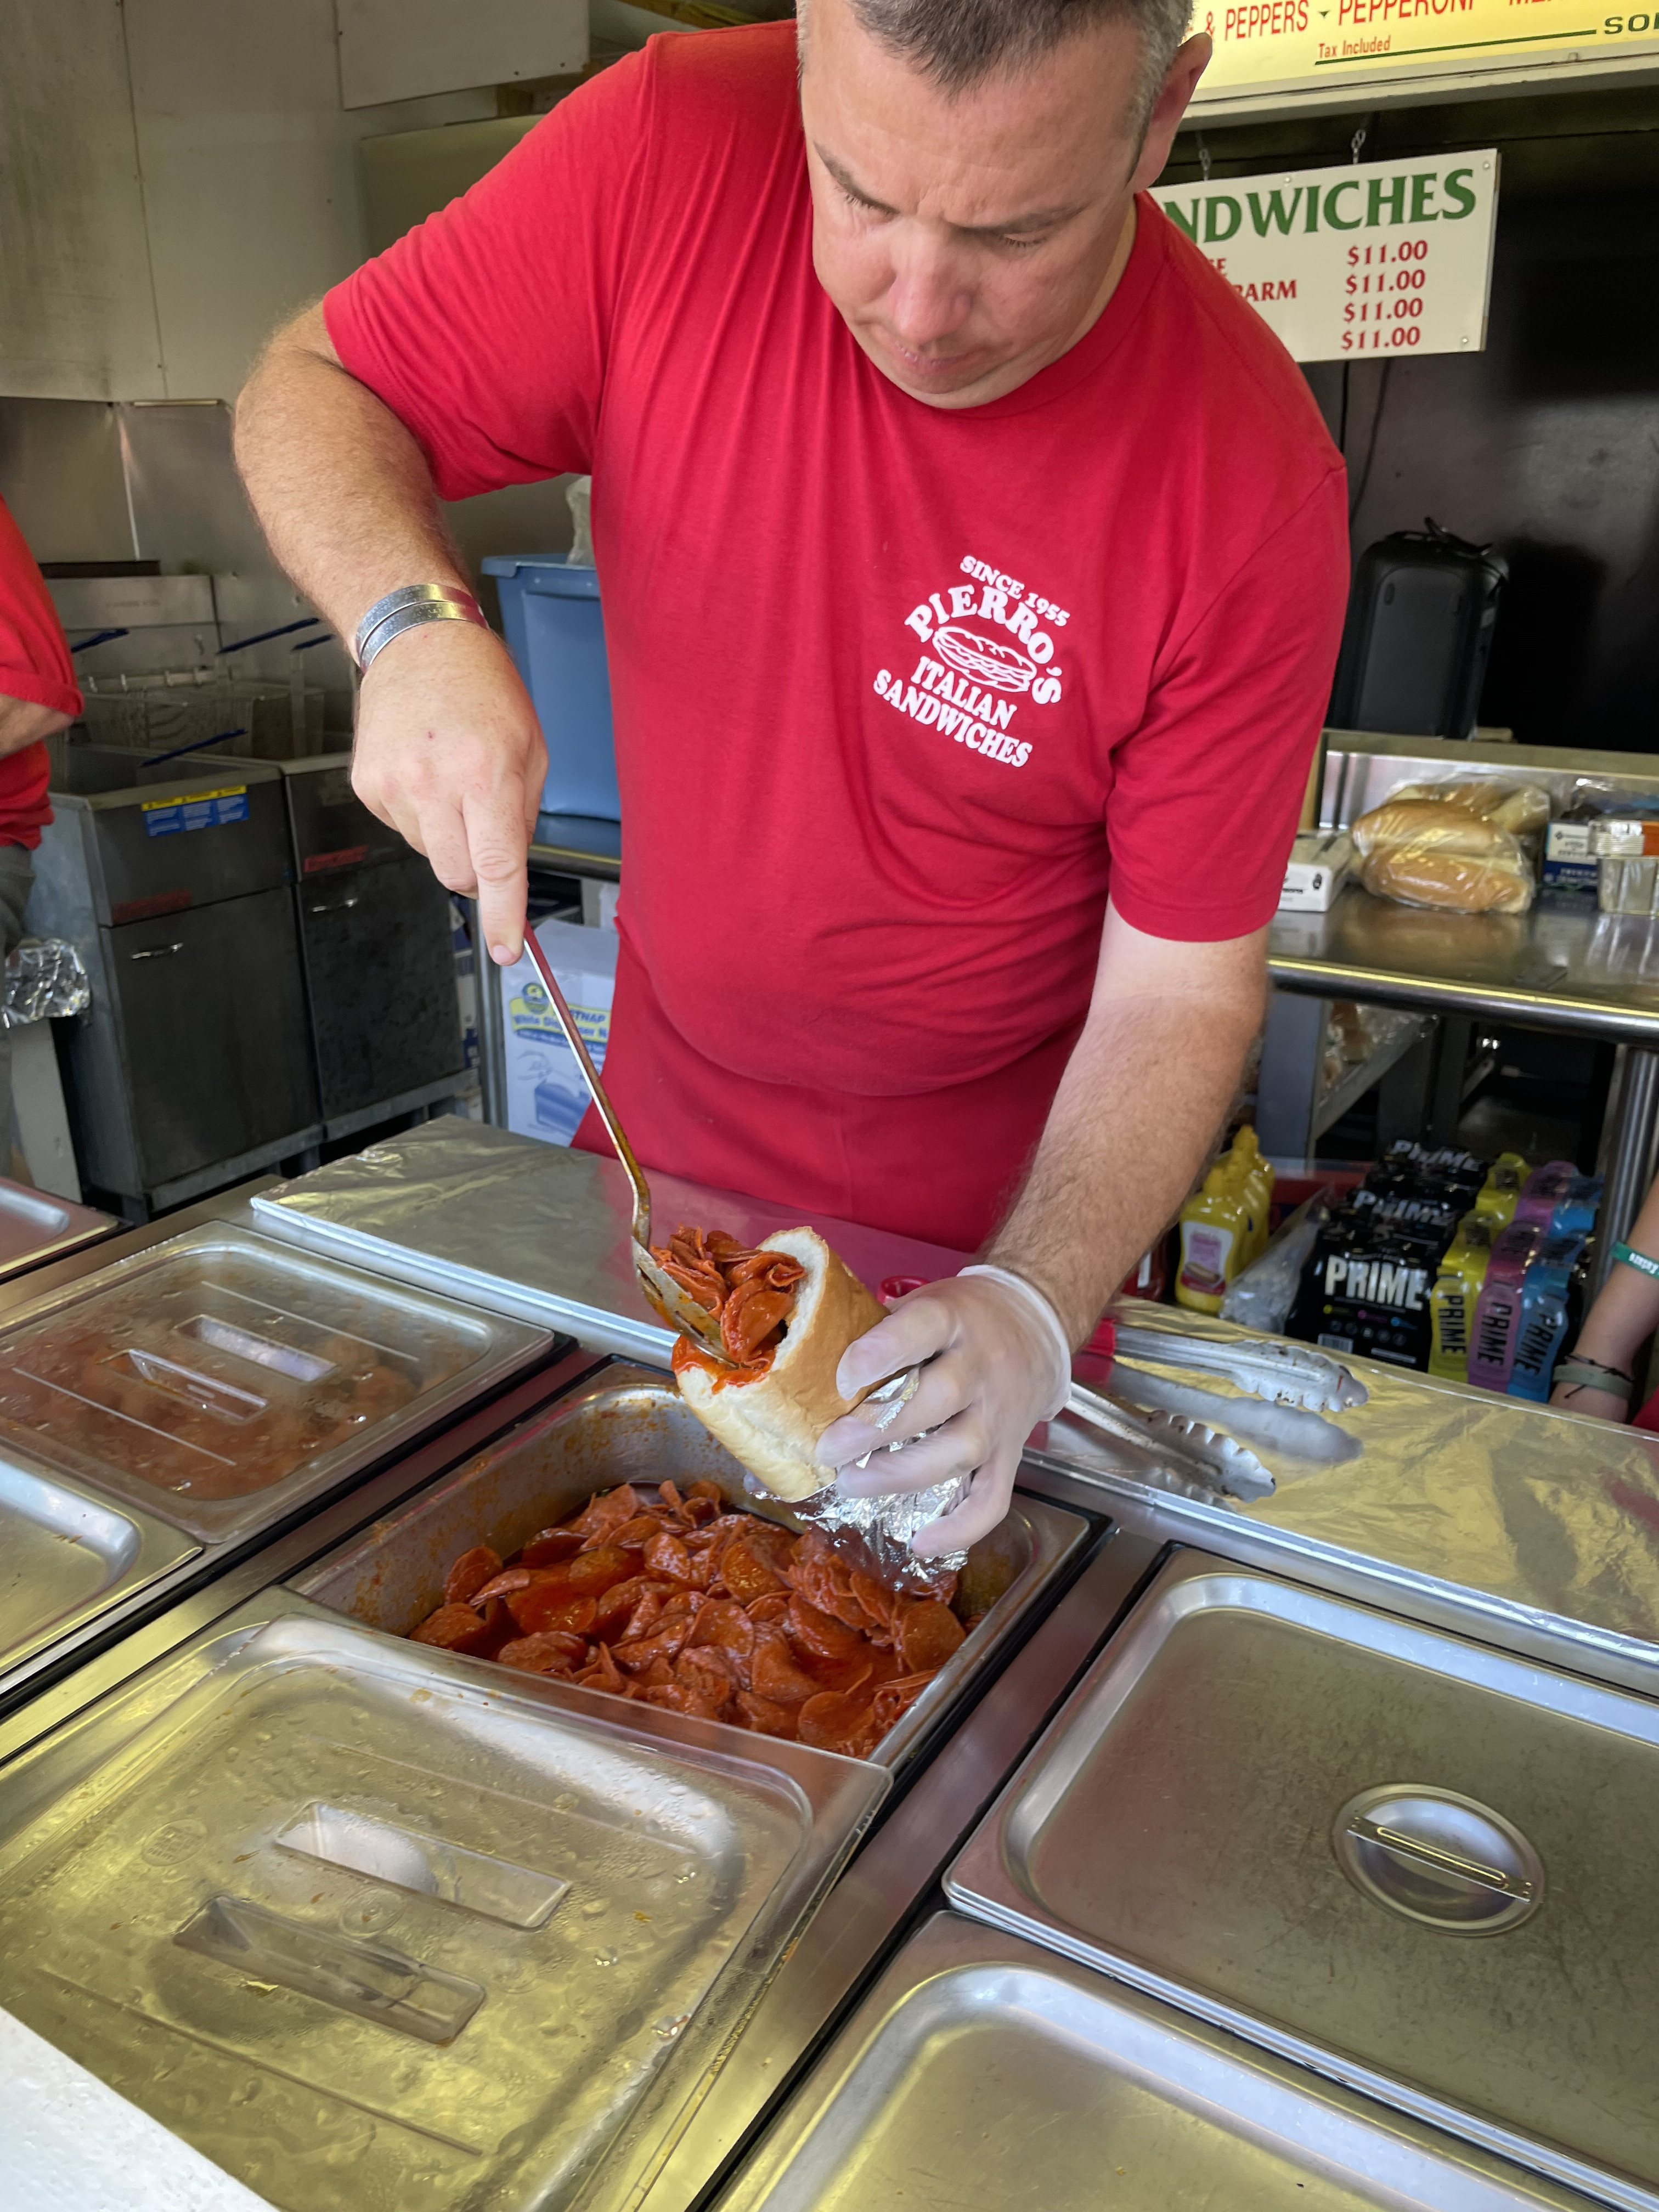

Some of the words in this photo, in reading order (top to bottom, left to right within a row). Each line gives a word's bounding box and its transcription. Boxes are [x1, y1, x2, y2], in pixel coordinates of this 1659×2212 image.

[1224, 0, 1309, 41] PEPPERS
[1318, 43, 1337, 59] Tax
[1342, 35, 1391, 55] Included
[1346, 269, 1425, 295] $11.00
[1347, 240, 1428, 267] $11.00
[1341, 326, 1420, 350] $11.00
[1344, 298, 1423, 323] $11.00
[960, 556, 1025, 600] SINCE
[1025, 592, 1070, 627] 1955
[904, 584, 1063, 704] PIERRO'S
[873, 669, 1033, 767] SANDWICHES
[911, 656, 1017, 730] ITALIAN
[1324, 1254, 1428, 1311] PRIME
[1438, 1295, 1466, 1355] PRIME
[1477, 1302, 1513, 1366] PRIME
[1514, 1313, 1557, 1375] PRIME
